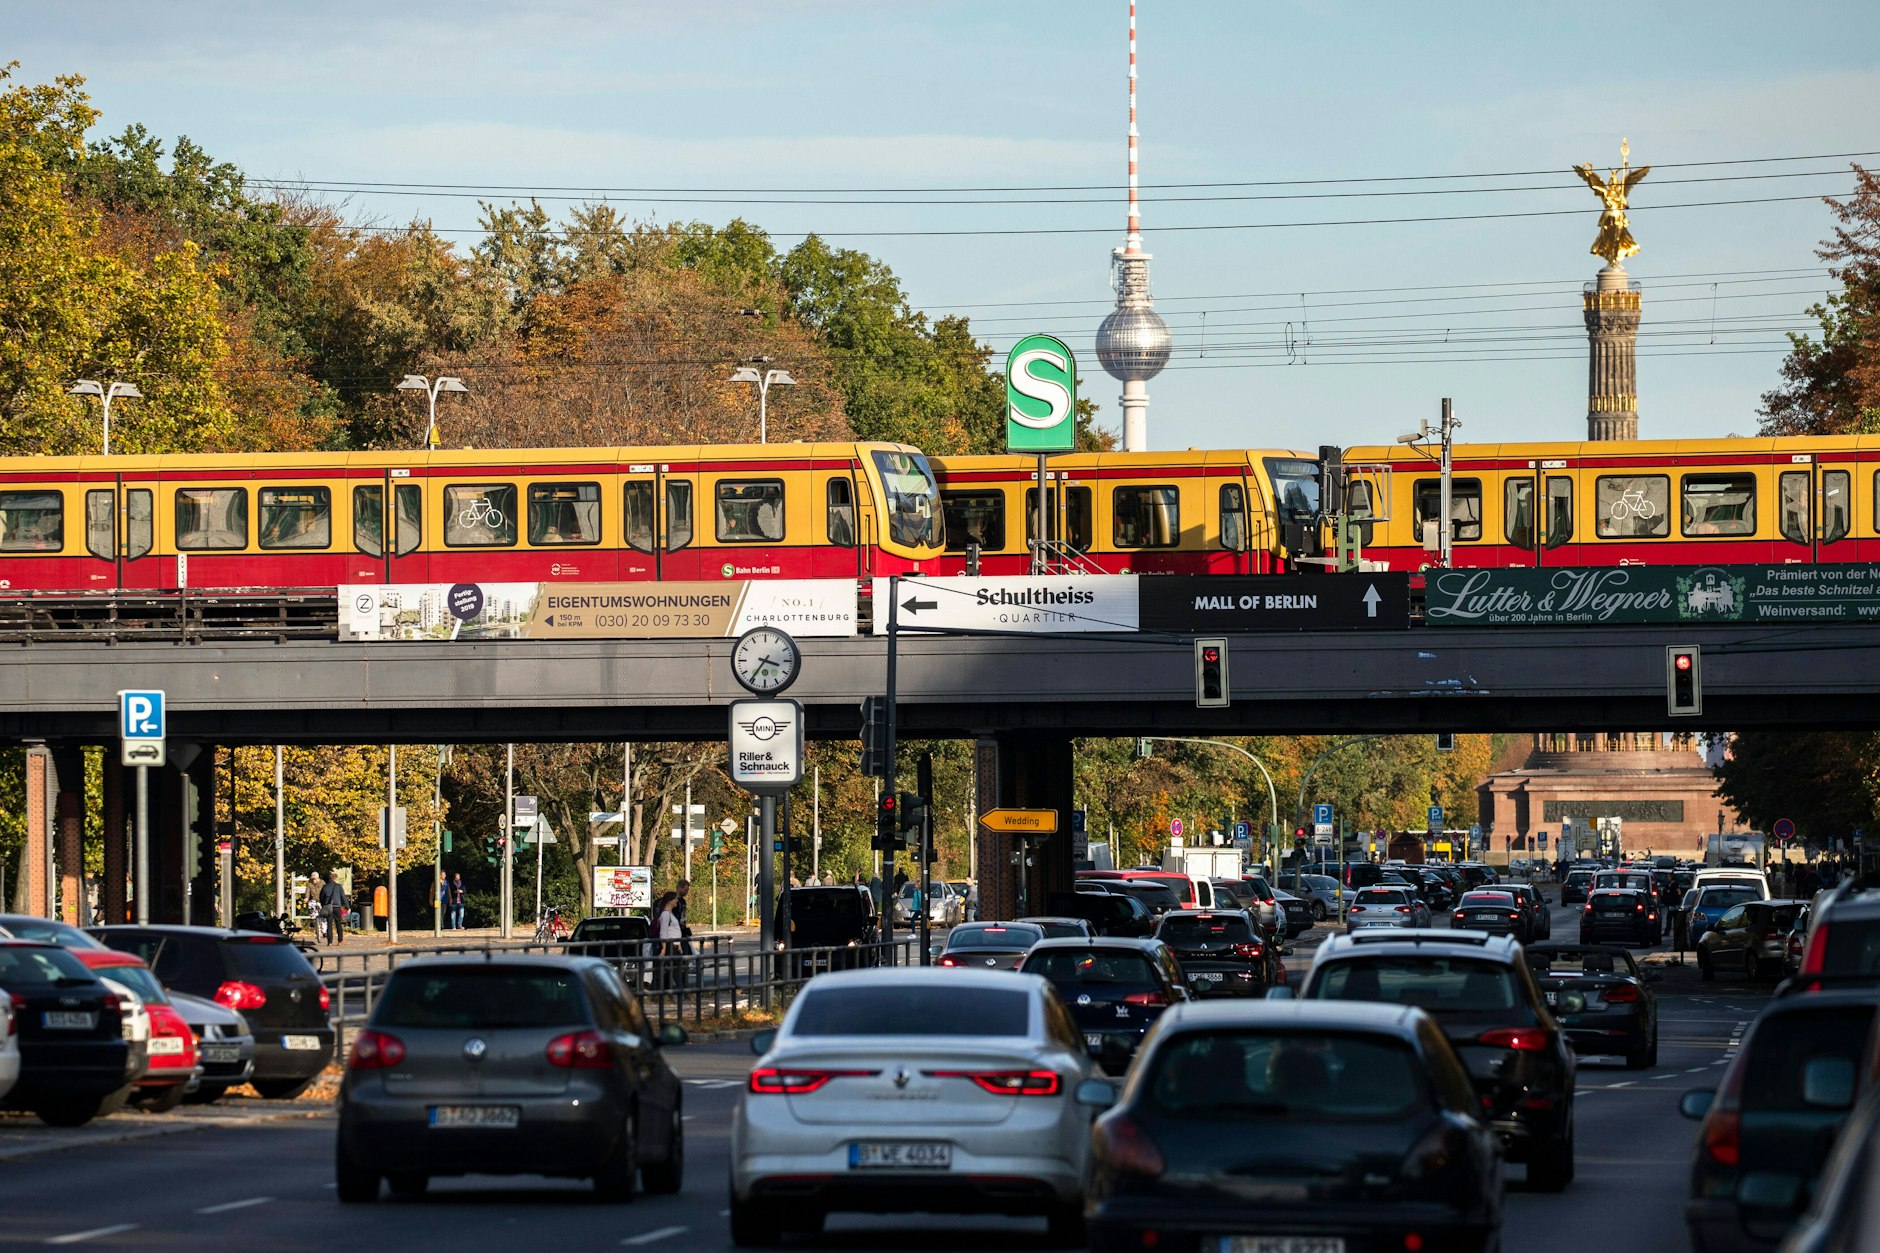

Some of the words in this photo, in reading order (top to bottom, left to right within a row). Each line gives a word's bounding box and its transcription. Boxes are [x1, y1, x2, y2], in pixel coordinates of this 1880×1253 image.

[1009, 349, 1071, 430] S
[735, 566, 751, 574] Bahn
[752, 566, 770, 574] Berlin
[1767, 569, 1817, 580] Prämiert
[1820, 571, 1843, 580] von
[1846, 569, 1866, 580] der
[976, 586, 1094, 606] Schultheiss
[1428, 570, 1534, 619] Lutter
[1538, 590, 1553, 612] &
[1551, 569, 1672, 620] Wegner
[1782, 584, 1815, 596] beste
[1818, 584, 1874, 595] Schnitzel
[455, 596, 477, 607] stellung
[548, 595, 730, 609] EIGENTUMSWOHNUNGEN
[1195, 596, 1235, 610] MALL
[1239, 596, 1260, 610] OF
[1265, 595, 1317, 609] BERLIN
[460, 604, 475, 613] 2019
[1758, 604, 1846, 616] Weinversand:
[595, 614, 628, 627] (030)
[632, 615, 649, 626] 20
[653, 615, 670, 626] 09
[674, 615, 690, 626] 73
[693, 614, 710, 626] 30
[746, 614, 849, 622] CHARLOTTENBURG
[1489, 613, 1509, 622] über
[1511, 613, 1526, 621] 200
[1528, 613, 1553, 622] Jahre
[1555, 612, 1564, 621] in
[1566, 612, 1593, 622] Berlin
[128, 696, 153, 733] P
[739, 752, 765, 761] Riller
[765, 752, 773, 761] &
[740, 762, 790, 771] Schnauck
[1319, 807, 1329, 822] P
[1431, 808, 1440, 820] P
[1004, 816, 1040, 827] Wedding
[906, 1144, 946, 1161] 4034
